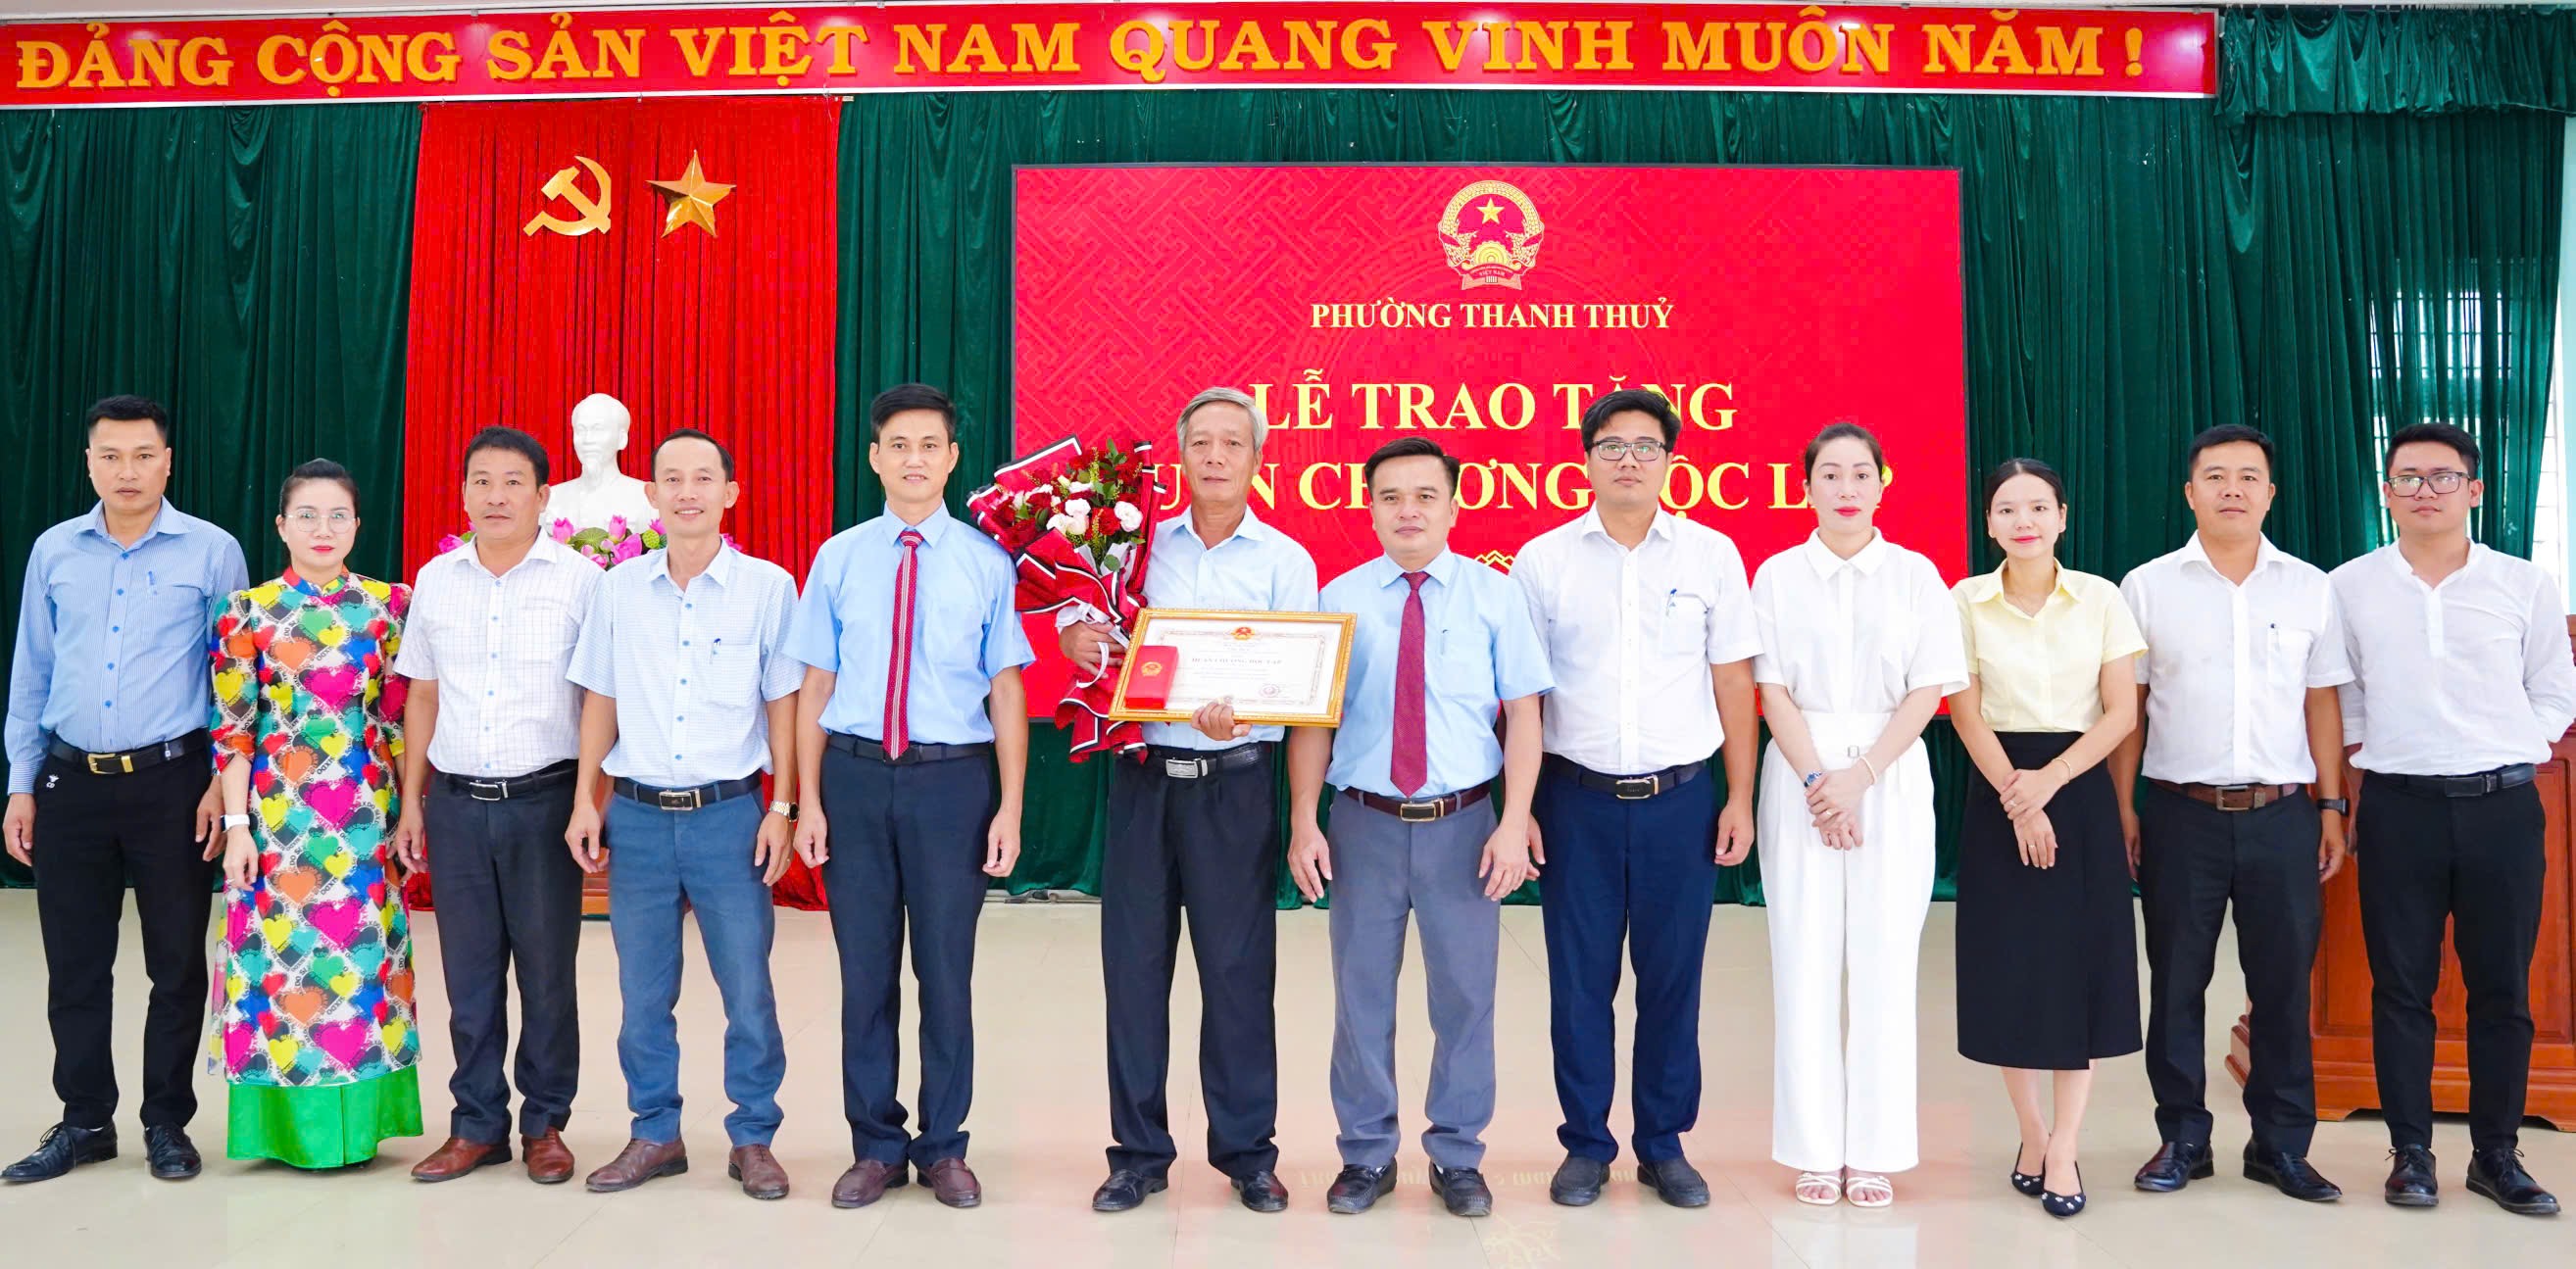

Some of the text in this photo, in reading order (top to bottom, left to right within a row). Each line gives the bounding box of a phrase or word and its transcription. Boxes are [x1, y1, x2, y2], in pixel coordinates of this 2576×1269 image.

[16, 20, 233, 89] ĐẢNG
[257, 20, 461, 97] CỘNG
[485, 11, 646, 81] SẢN
[669, 9, 868, 87] VIỆT
[893, 23, 1081, 74] NAM
[1110, 18, 1398, 84] QUANG
[1421, 20, 1635, 72] VINH
[1661, 5, 1896, 74] MUÔN
[1922, 8, 2105, 76] NĂM
[1311, 297, 1674, 328] PHƯỜNG THANH THUỶ
[1248, 367, 1333, 430] LỄ
[1351, 382, 1536, 430] TRAO
[1659, 455, 1750, 518] ỘC
